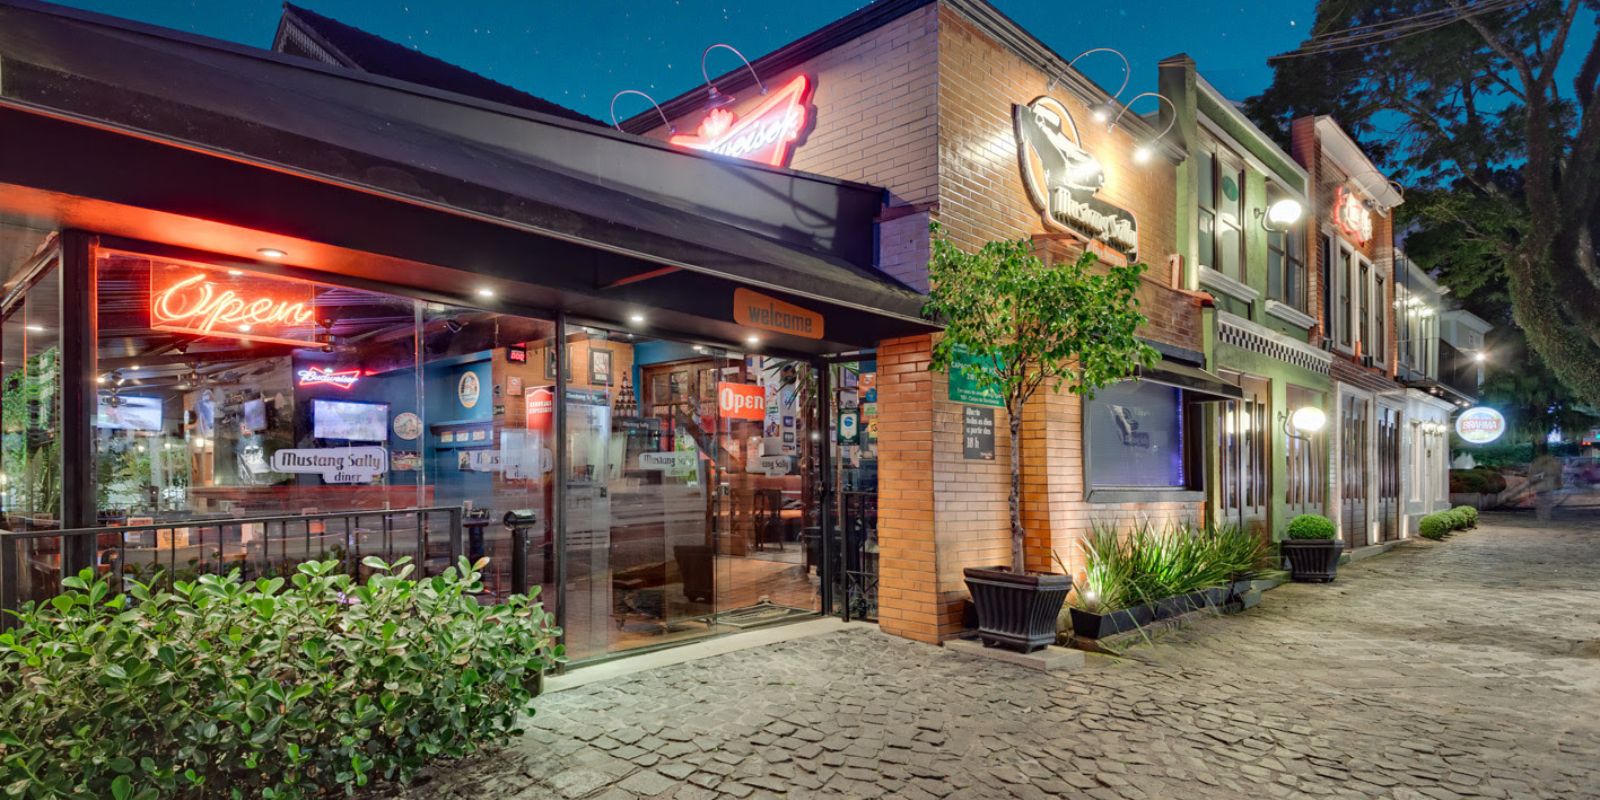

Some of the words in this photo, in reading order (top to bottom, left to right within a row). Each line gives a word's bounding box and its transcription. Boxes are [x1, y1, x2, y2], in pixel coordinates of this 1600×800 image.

[1054, 186, 1109, 241] Mustang
[1108, 214, 1138, 253] Sally
[154, 273, 313, 334] Open
[749, 303, 812, 333] welcome
[721, 387, 764, 413] Open
[281, 452, 344, 470] Mustang
[347, 449, 381, 472] Sally
[334, 470, 362, 483] diner
